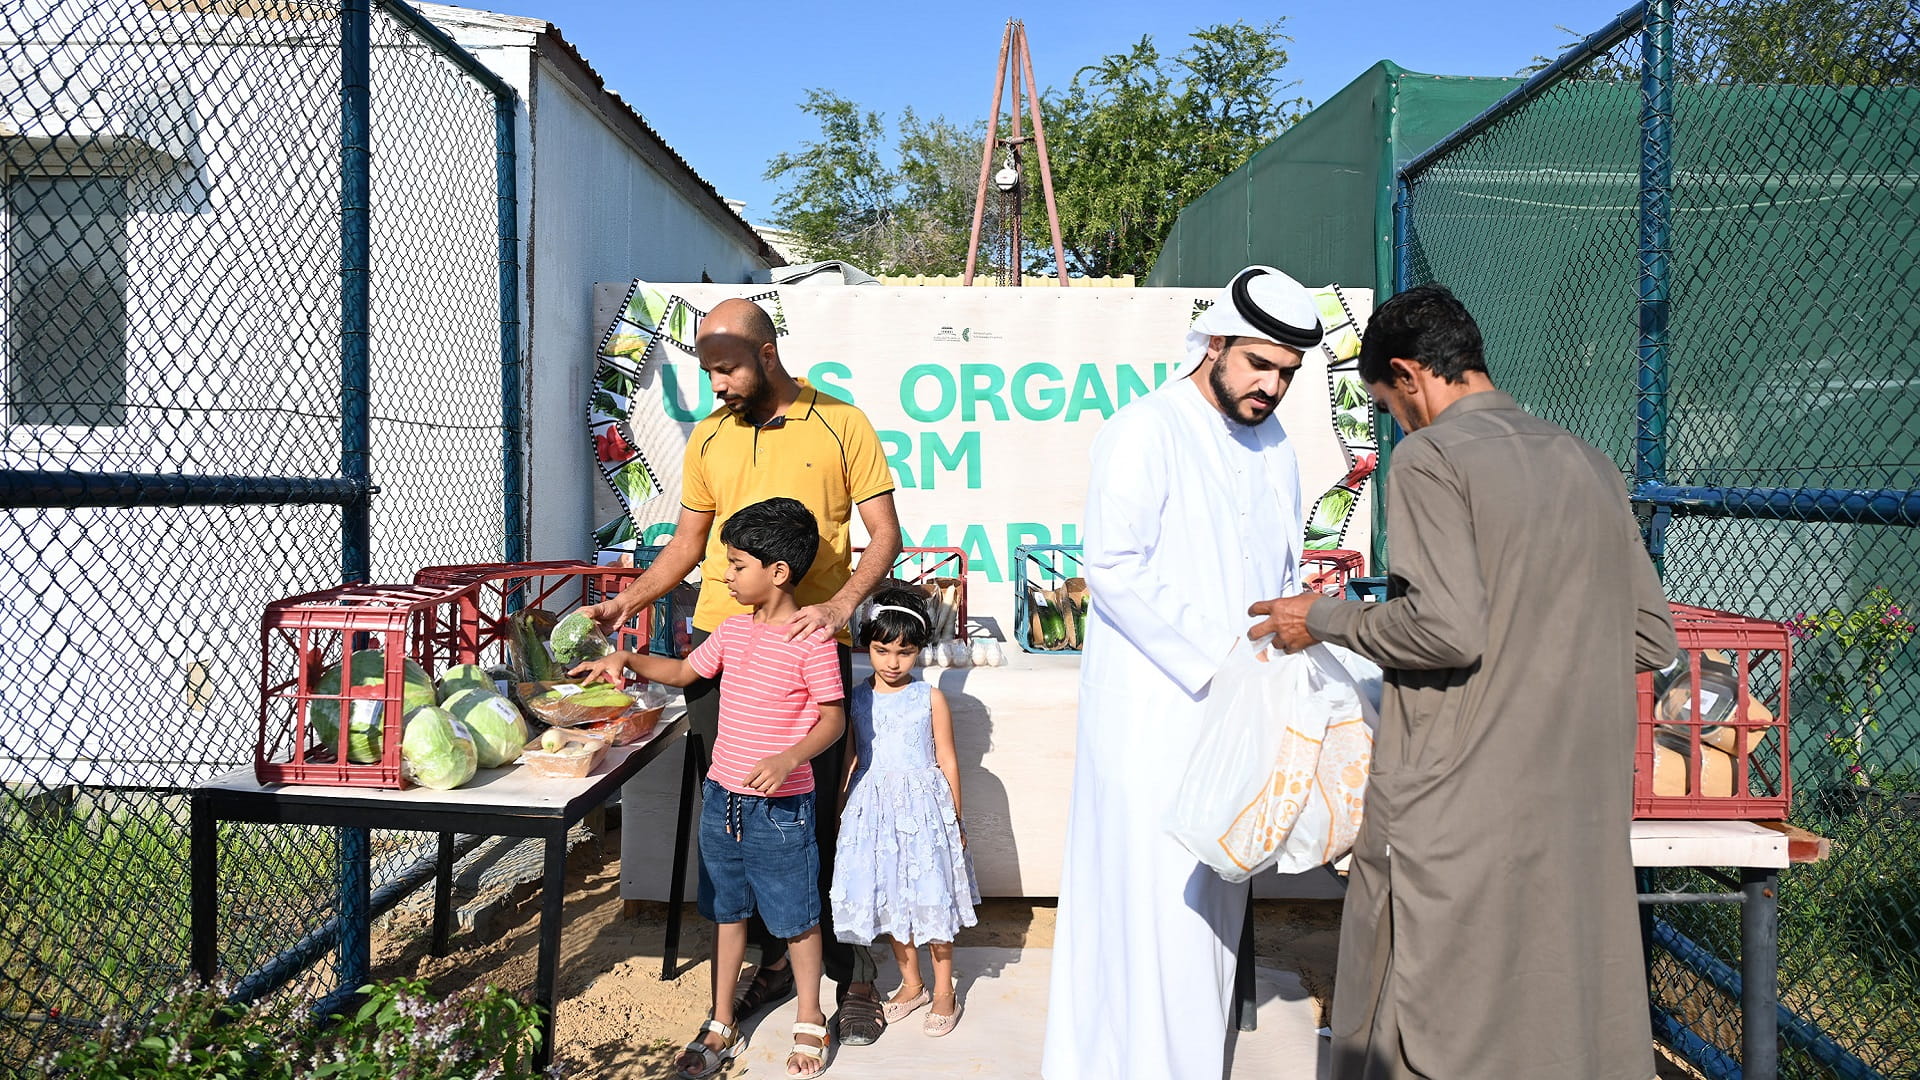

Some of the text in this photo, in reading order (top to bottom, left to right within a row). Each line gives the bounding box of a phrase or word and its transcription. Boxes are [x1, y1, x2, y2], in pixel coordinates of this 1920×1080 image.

[662, 361, 1182, 422] US ORGAN
[875, 430, 981, 490] RM
